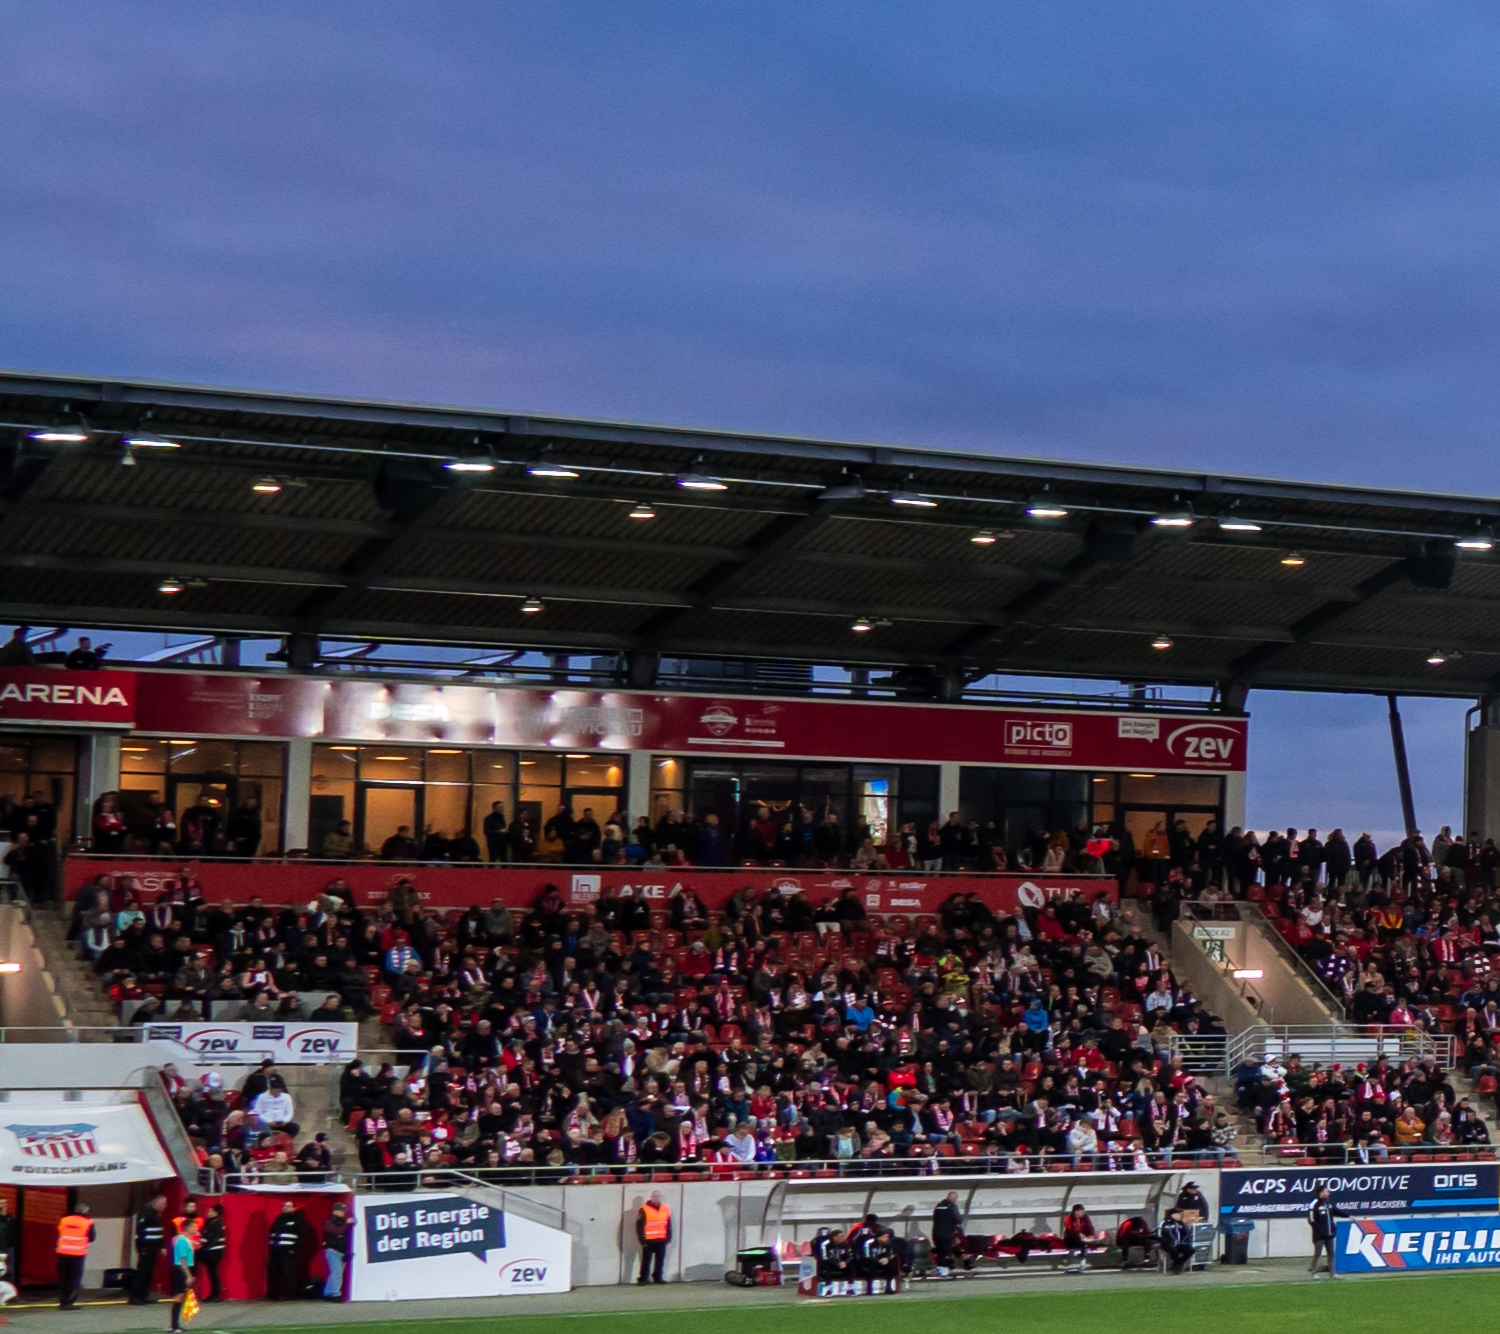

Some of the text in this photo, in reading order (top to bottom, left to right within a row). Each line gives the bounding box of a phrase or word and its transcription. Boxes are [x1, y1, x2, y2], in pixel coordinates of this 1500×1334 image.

[1, 683, 128, 707] ARENA
[1011, 720, 1070, 746] picto
[1184, 736, 1235, 759] zev
[199, 1038, 239, 1052] zev
[301, 1037, 340, 1054] zev
[1238, 1174, 1411, 1196] ACPS AUTOMOTIVE
[376, 1203, 490, 1231] Die Energie
[376, 1227, 485, 1253] der Region
[1435, 1252, 1461, 1265] IHR
[511, 1266, 548, 1283] zev
